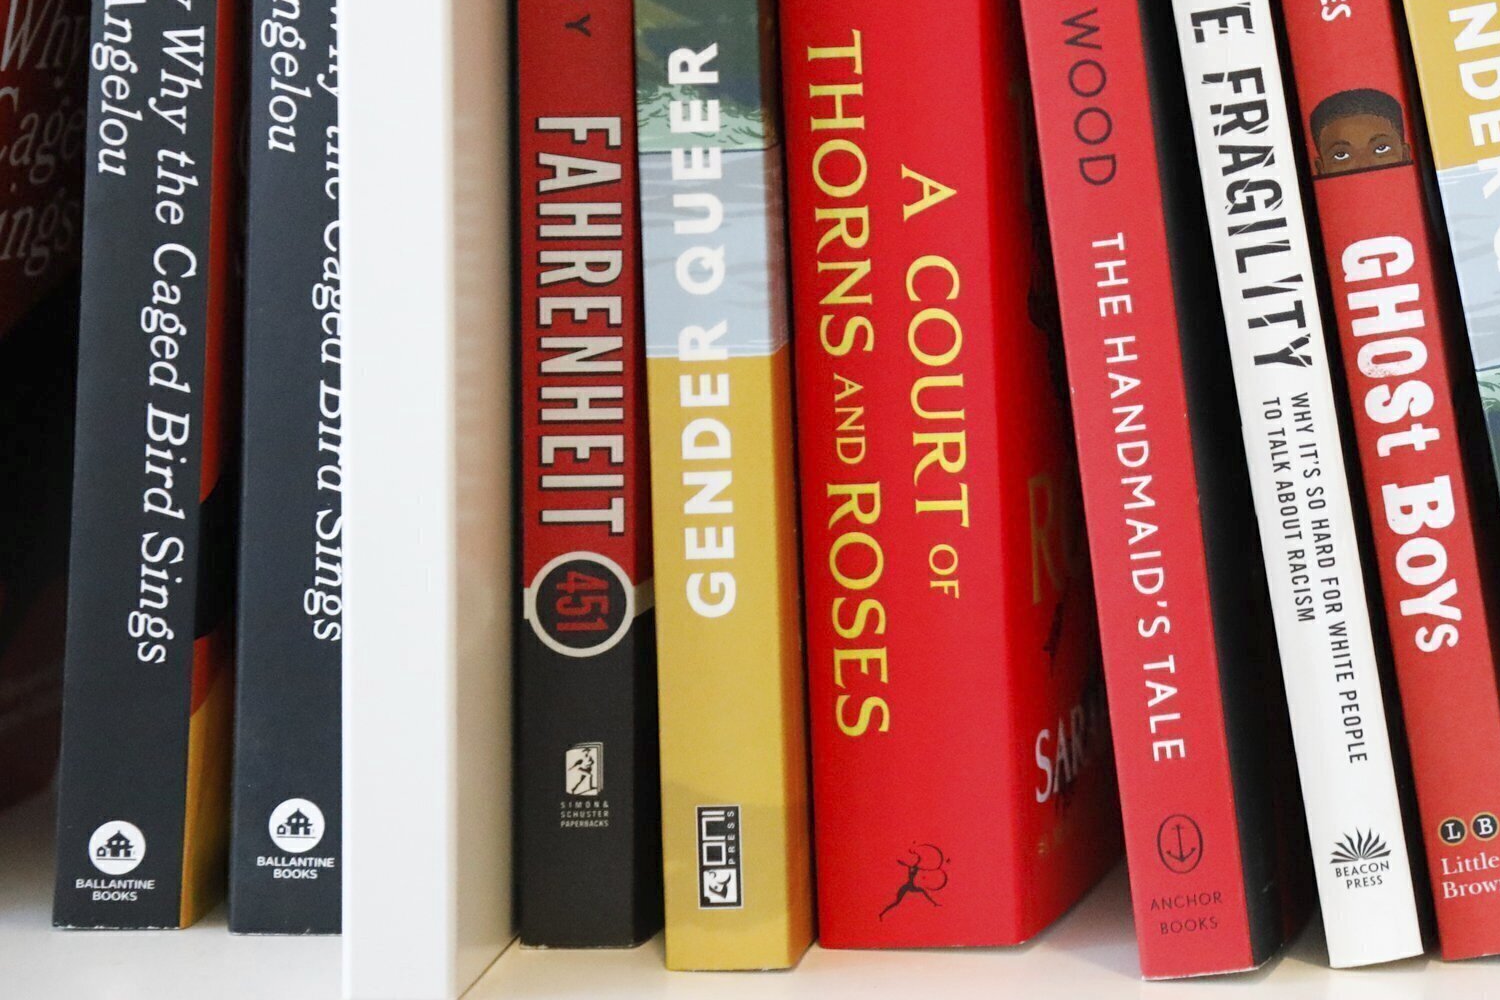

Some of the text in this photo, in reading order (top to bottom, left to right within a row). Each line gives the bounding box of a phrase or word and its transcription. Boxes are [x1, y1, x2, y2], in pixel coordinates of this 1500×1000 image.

[149, 26, 205, 134] Why
[154, 149, 196, 226] the
[1201, 66, 1312, 368] FRAGILITY
[140, 242, 197, 393] Caged
[535, 115, 625, 536] FAHRENHEIT
[668, 41, 738, 618] QUEER GENDER
[807, 29, 891, 737] THORNS AND ROSES
[901, 164, 971, 600] A COURT OF
[143, 403, 191, 520] Bird
[1091, 231, 1187, 763] THE HANDMAID'S TALE
[1261, 396, 1317, 624] TO TALK ABOUT RACISM
[127, 532, 186, 664] Sings
[555, 570, 610, 633] 451
[1291, 392, 1368, 765] WHY IT'S SO HARD FOR WHITE PEOPLE
[560, 810, 610, 819] SCHUSTER
[560, 819, 610, 829] PAPERBACKS
[726, 810, 736, 866] PRESS
[75, 877, 156, 892] BALLANTINE
[92, 889, 139, 902] BOOKS
[256, 855, 335, 870] BALLANTINE
[273, 867, 318, 880] BOOKS
[1150, 890, 1223, 912] ANCHOR
[1334, 859, 1391, 879] BEACON
[1345, 872, 1384, 890] PRESS
[1160, 916, 1219, 936] BOOKS
